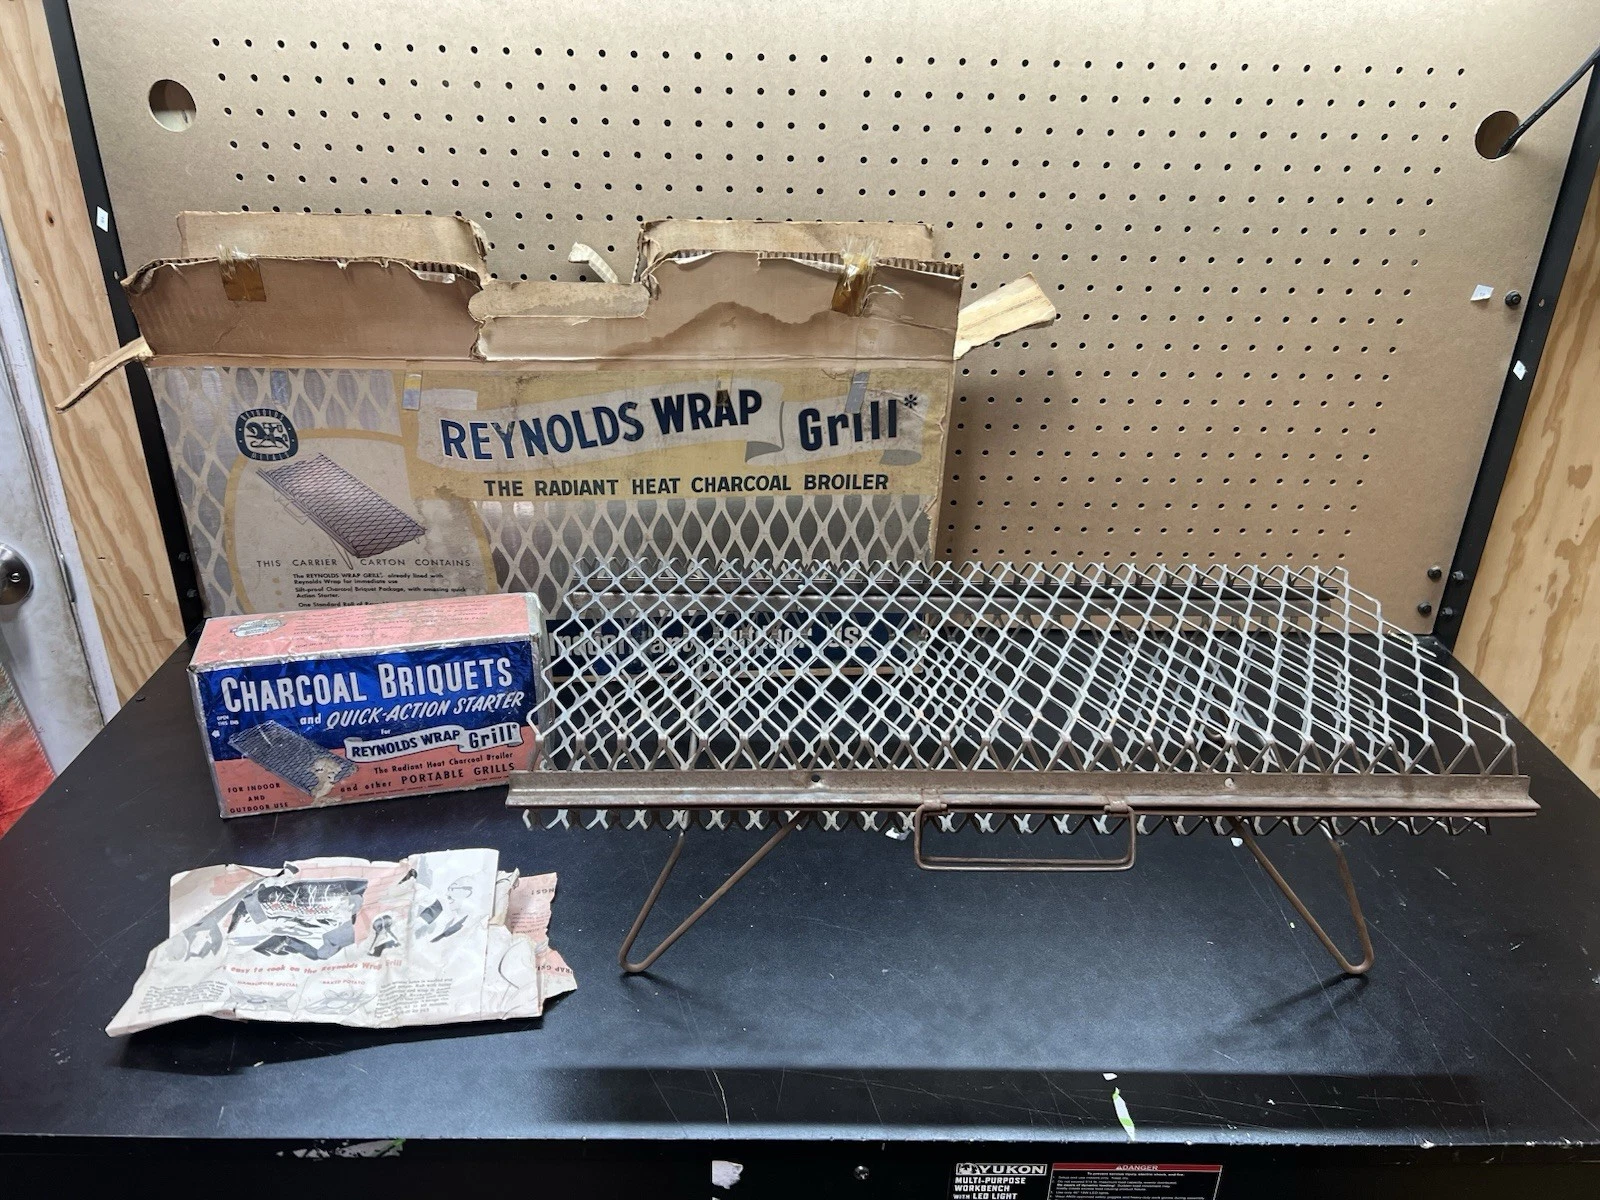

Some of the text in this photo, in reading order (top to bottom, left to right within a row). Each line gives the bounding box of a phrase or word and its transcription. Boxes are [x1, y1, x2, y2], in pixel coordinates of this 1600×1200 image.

[440, 401, 644, 460] REYNOLDS
[650, 389, 762, 435] WRAP
[483, 473, 889, 496] THE RADIANT HEAT CHARCOAL BROILER
[257, 560, 281, 568] THIS
[292, 559, 338, 567] CARRIER
[360, 558, 405, 566] CARTON
[221, 657, 513, 712] CHARCOAL BRIQUETS
[299, 691, 525, 730] and QUICK-ACTION STARTER
[351, 737, 418, 757] REYNOLDS
[420, 730, 460, 746] WRAP
[374, 752, 513, 774] The Radiant Heat Charcoal Broiler
[247, 782, 280, 791] INDOOR
[340, 784, 358, 793] and
[365, 780, 392, 790] other
[401, 768, 464, 785] PORTABLE
[474, 762, 515, 776] GRILLS
[230, 804, 270, 813] OUTDOOR
[231, 965, 250, 974] easy
[267, 964, 285, 972] cook
[978, 1165, 1044, 1174] YUKON
[954, 1184, 1010, 1192] WORKBENCH
